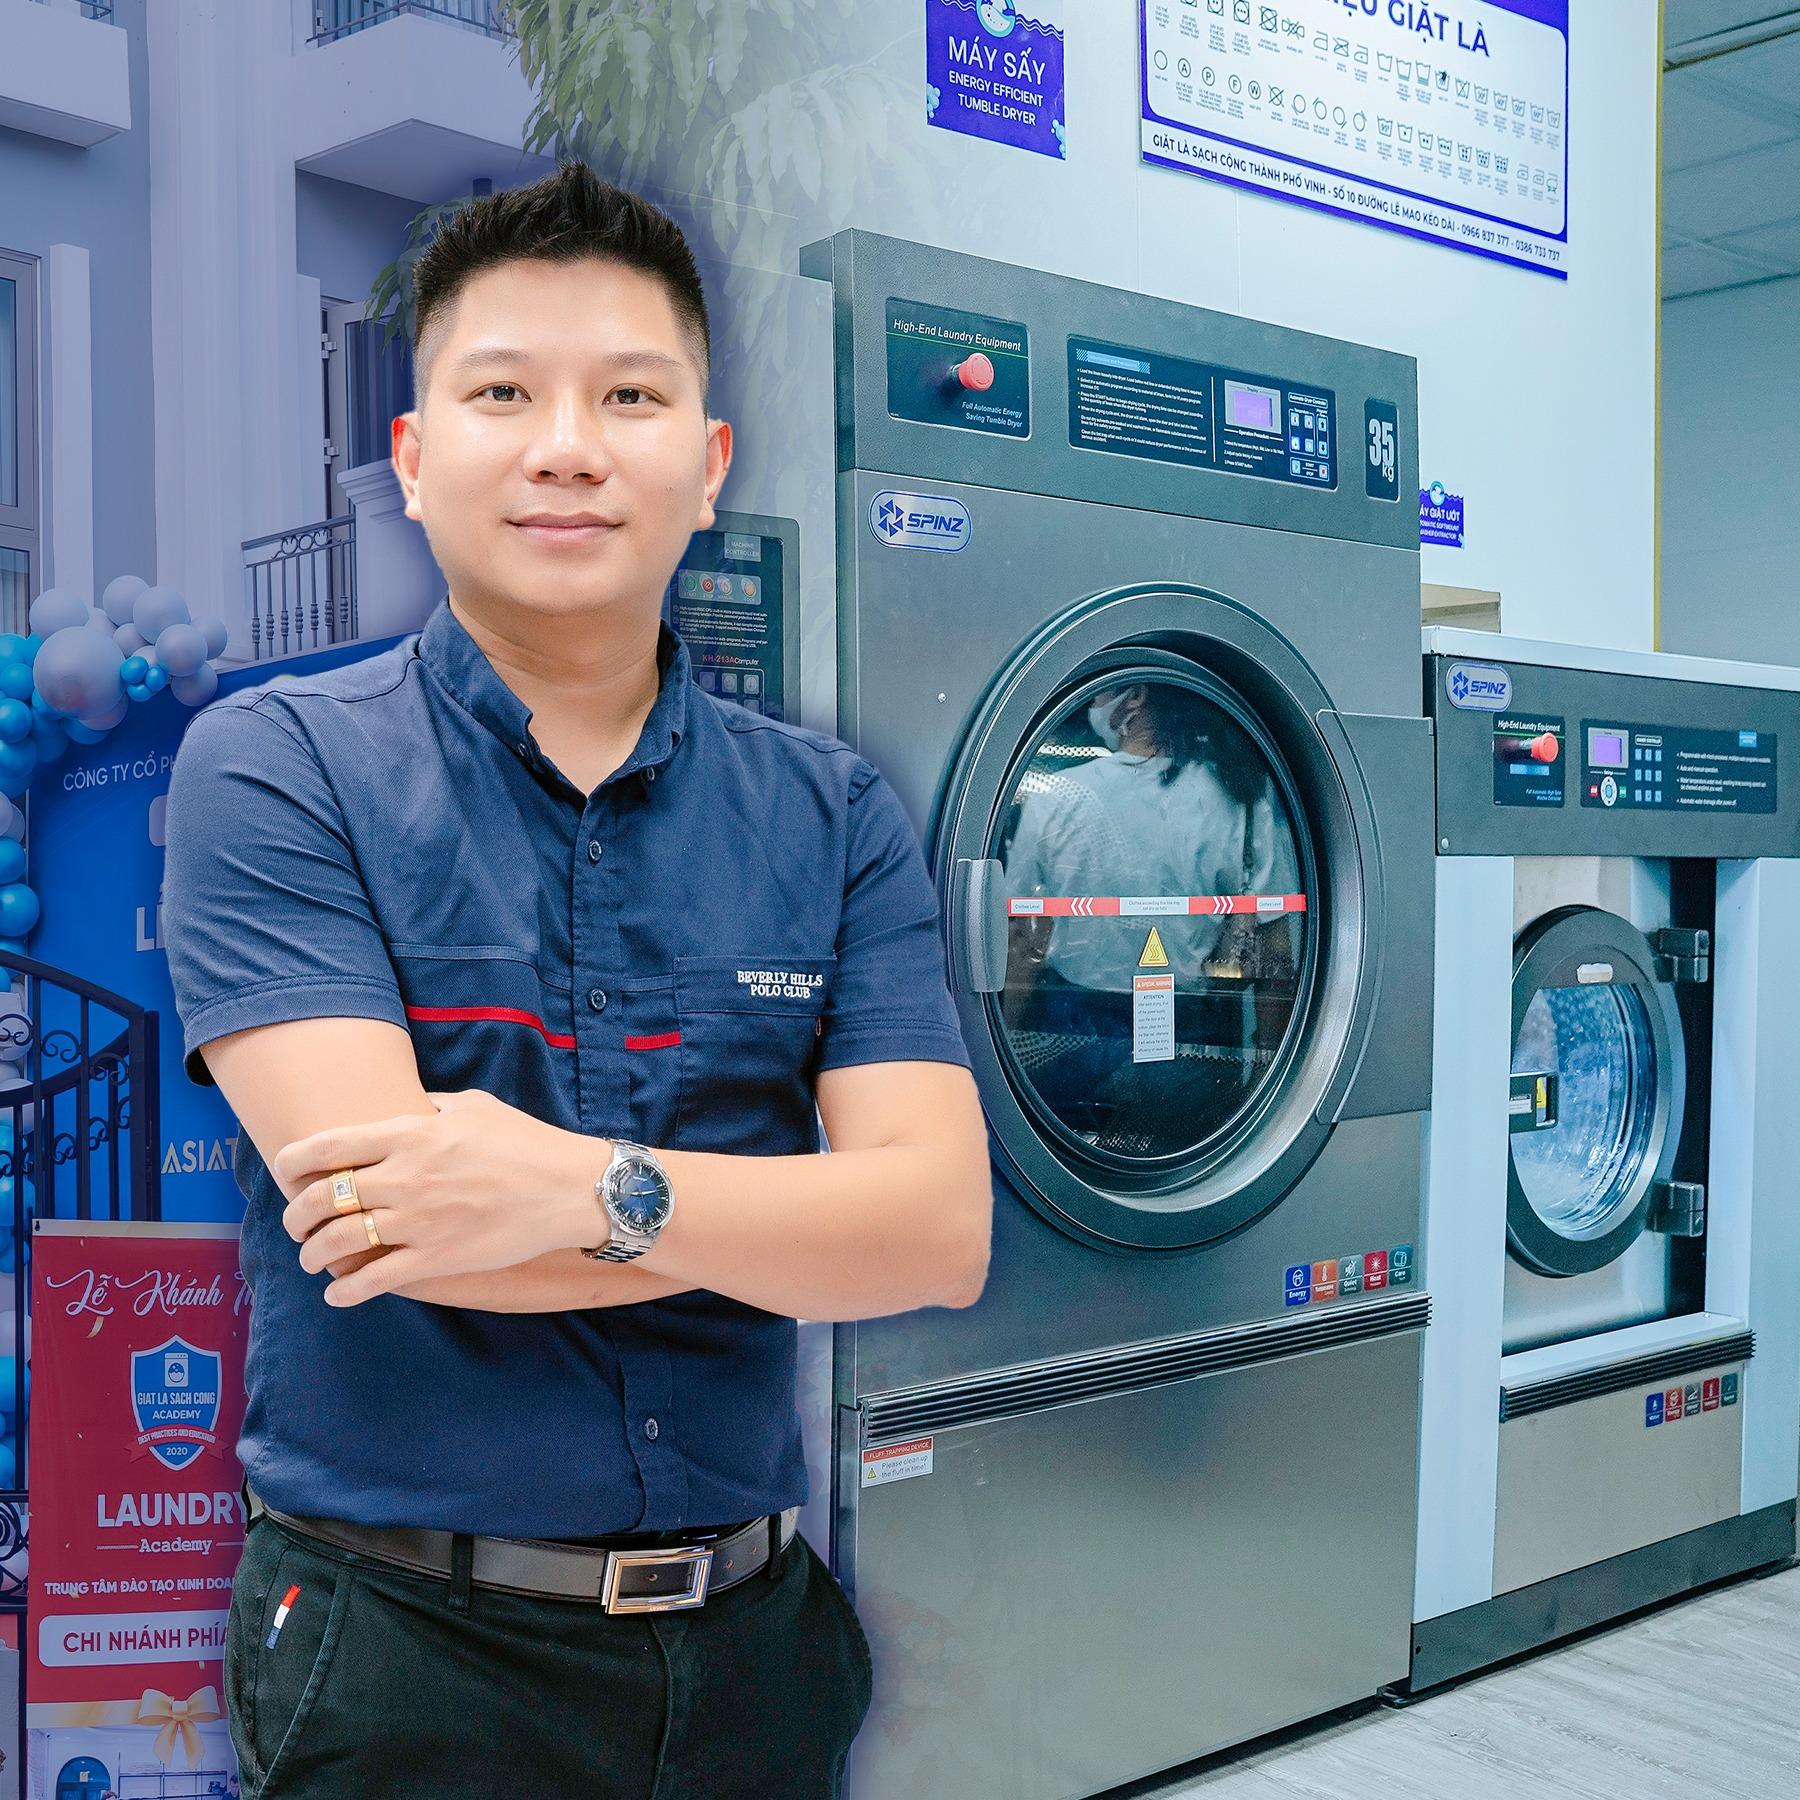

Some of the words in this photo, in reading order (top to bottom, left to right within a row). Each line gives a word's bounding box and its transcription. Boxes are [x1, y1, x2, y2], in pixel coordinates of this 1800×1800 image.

[1387, 0, 1449, 43] GIẶT
[1458, 21, 1490, 57] LÀ
[949, 36, 997, 71] MÁY
[1003, 47, 1045, 85] SẤY
[949, 70, 991, 92] ENERGY
[993, 82, 1043, 107] EFFICIENT
[958, 93, 1000, 116] TUMBLE
[1002, 105, 1036, 126] DRYER
[1153, 134, 1175, 152] GIẶT
[1177, 140, 1190, 154] LÀ
[1192, 146, 1217, 163] SẠCH
[1220, 151, 1246, 172] CỘNG
[1249, 162, 1280, 182] THÀNH
[1283, 172, 1302, 187] PHỐ
[1304, 178, 1326, 195] VINH
[1333, 184, 1345, 200] SỐ
[1347, 190, 1355, 203] 10
[1358, 194, 1388, 213] ĐƯỜNG
[1391, 201, 1400, 216] LÊ
[1402, 206, 1420, 221] MAO
[1422, 211, 1439, 227] KÉO
[1442, 217, 1455, 232] DÀI
[893, 319, 936, 336] High-End
[938, 327, 974, 345] Laundry
[975, 333, 1021, 352] Equipment
[962, 402, 974, 410] Full
[974, 402, 1001, 414] Automatic
[1002, 407, 1023, 419] Energy
[965, 412, 985, 424] Saving
[986, 414, 1006, 426] Tumble
[1007, 418, 1023, 428] Dryer
[1368, 418, 1394, 467] 35
[1382, 462, 1394, 483] kg
[907, 513, 964, 532] SPINZ
[1470, 681, 1506, 695] SPINZ
[1519, 721, 1537, 731] Laundry
[1537, 722, 1560, 732] Equipment
[63, 768, 108, 791] CÔNG
[112, 763, 129, 783] TY
[133, 750, 156, 779] CỔ
[737, 970, 788, 984] BEVERLY
[790, 973, 823, 986] HILLS
[750, 984, 781, 996] POLO
[783, 985, 811, 998] CLUB
[47, 1269, 114, 1316] Lễ
[115, 1269, 224, 1316] Khánh
[1289, 1290, 1307, 1299] Energy
[1343, 1279, 1357, 1288] Quiet
[137, 1392, 156, 1405] GIAT
[158, 1392, 168, 1405] LA
[170, 1392, 192, 1405] SACH
[194, 1392, 216, 1405] CONG
[152, 1409, 201, 1419] ACADEMY
[137, 1434, 151, 1445] BEST
[886, 1445, 911, 1456] TRAPPING
[911, 1441, 929, 1451] DEVICE
[166, 1447, 188, 1456] 2020
[881, 1461, 903, 1469] Please
[903, 1456, 919, 1465] clean
[139, 1537, 212, 1555] Academy
[44, 1581, 89, 1595] TRUNG
[92, 1579, 117, 1594] TÂM
[120, 1578, 148, 1592] ĐÀO
[150, 1578, 174, 1594] TẠO
[177, 1578, 203, 1591] KINH
[63, 1632, 101, 1652] CHI
[109, 1624, 181, 1651] NHÁNH
